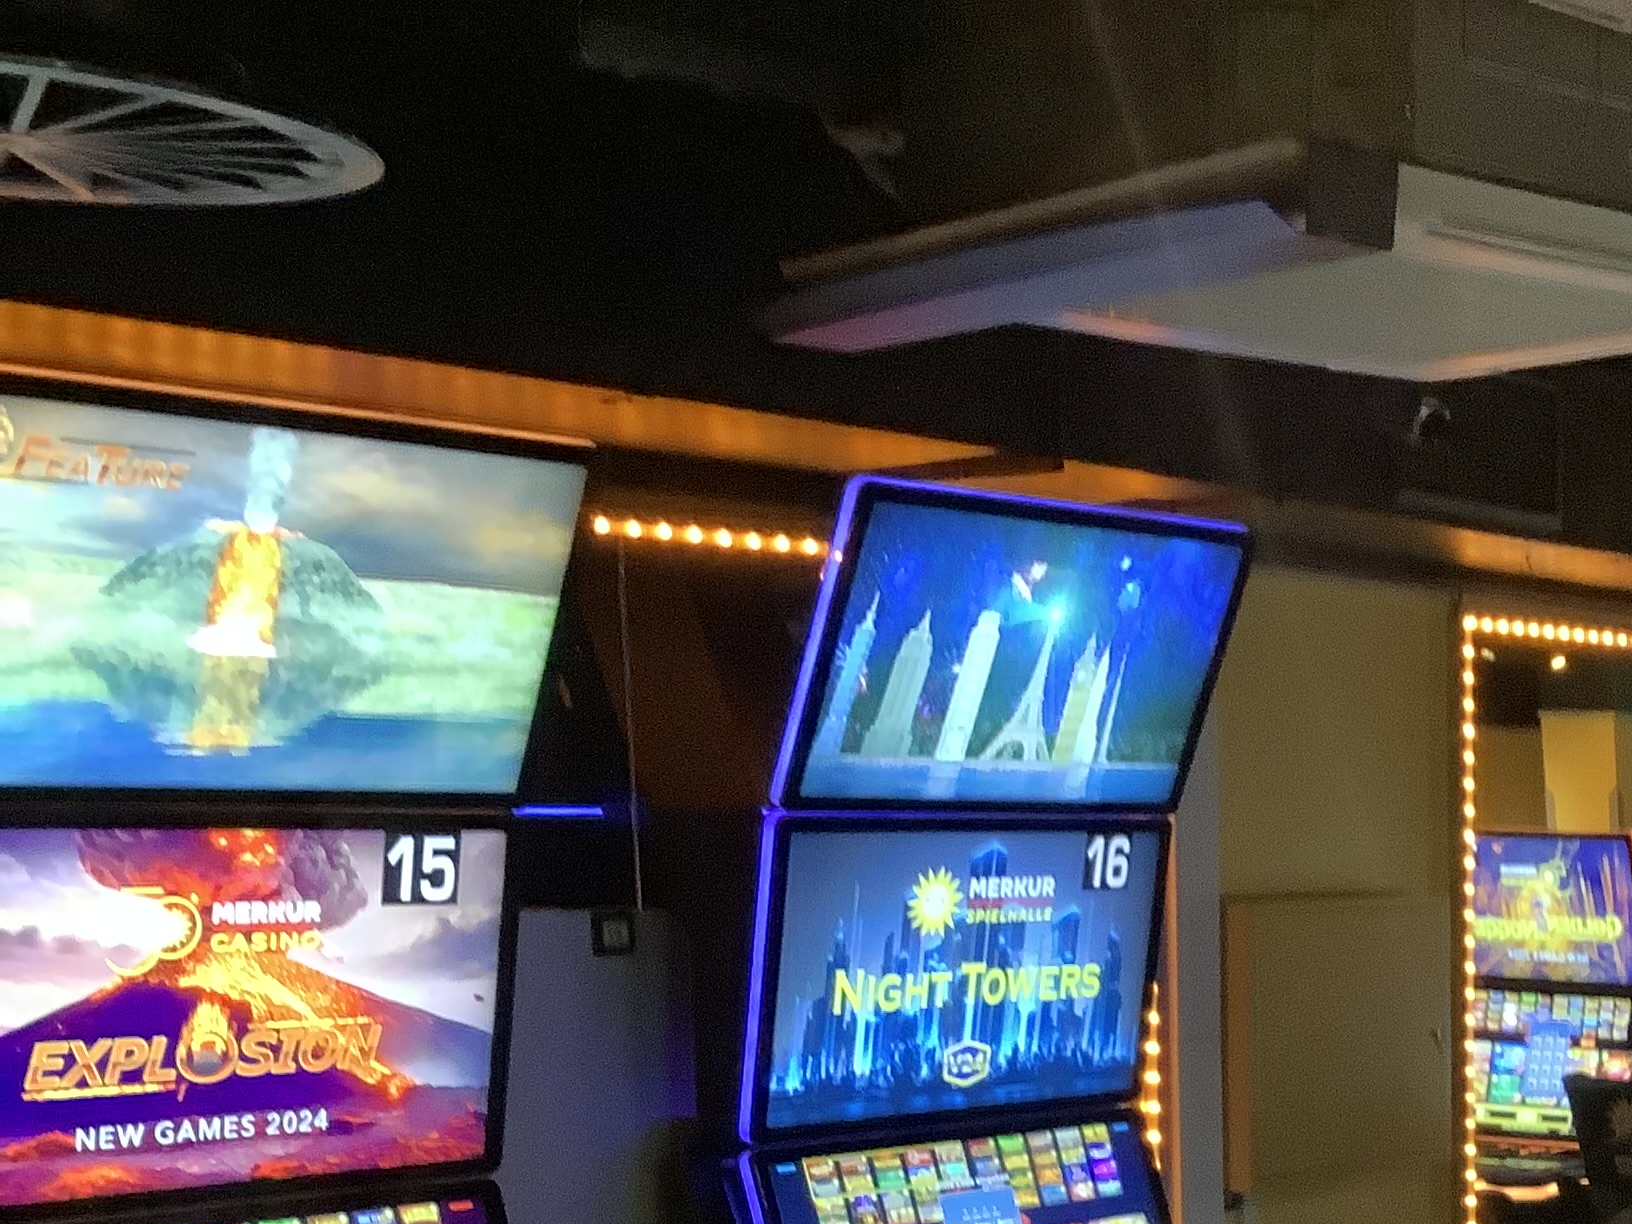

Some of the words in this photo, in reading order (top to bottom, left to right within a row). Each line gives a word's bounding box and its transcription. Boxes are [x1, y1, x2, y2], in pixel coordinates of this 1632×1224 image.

[386, 834, 457, 902] 15
[1086, 834, 1132, 889] 16
[969, 875, 1056, 900] MERKUR
[211, 900, 322, 926] MERKUR
[210, 929, 323, 954] CASINO
[832, 968, 953, 1017] NIGHT
[961, 961, 1102, 1007] TOWERS
[24, 1020, 384, 1099] EXPLOSION
[75, 1122, 145, 1153] NEW
[154, 1115, 256, 1144] GAMES
[266, 1109, 329, 1136] 2024
